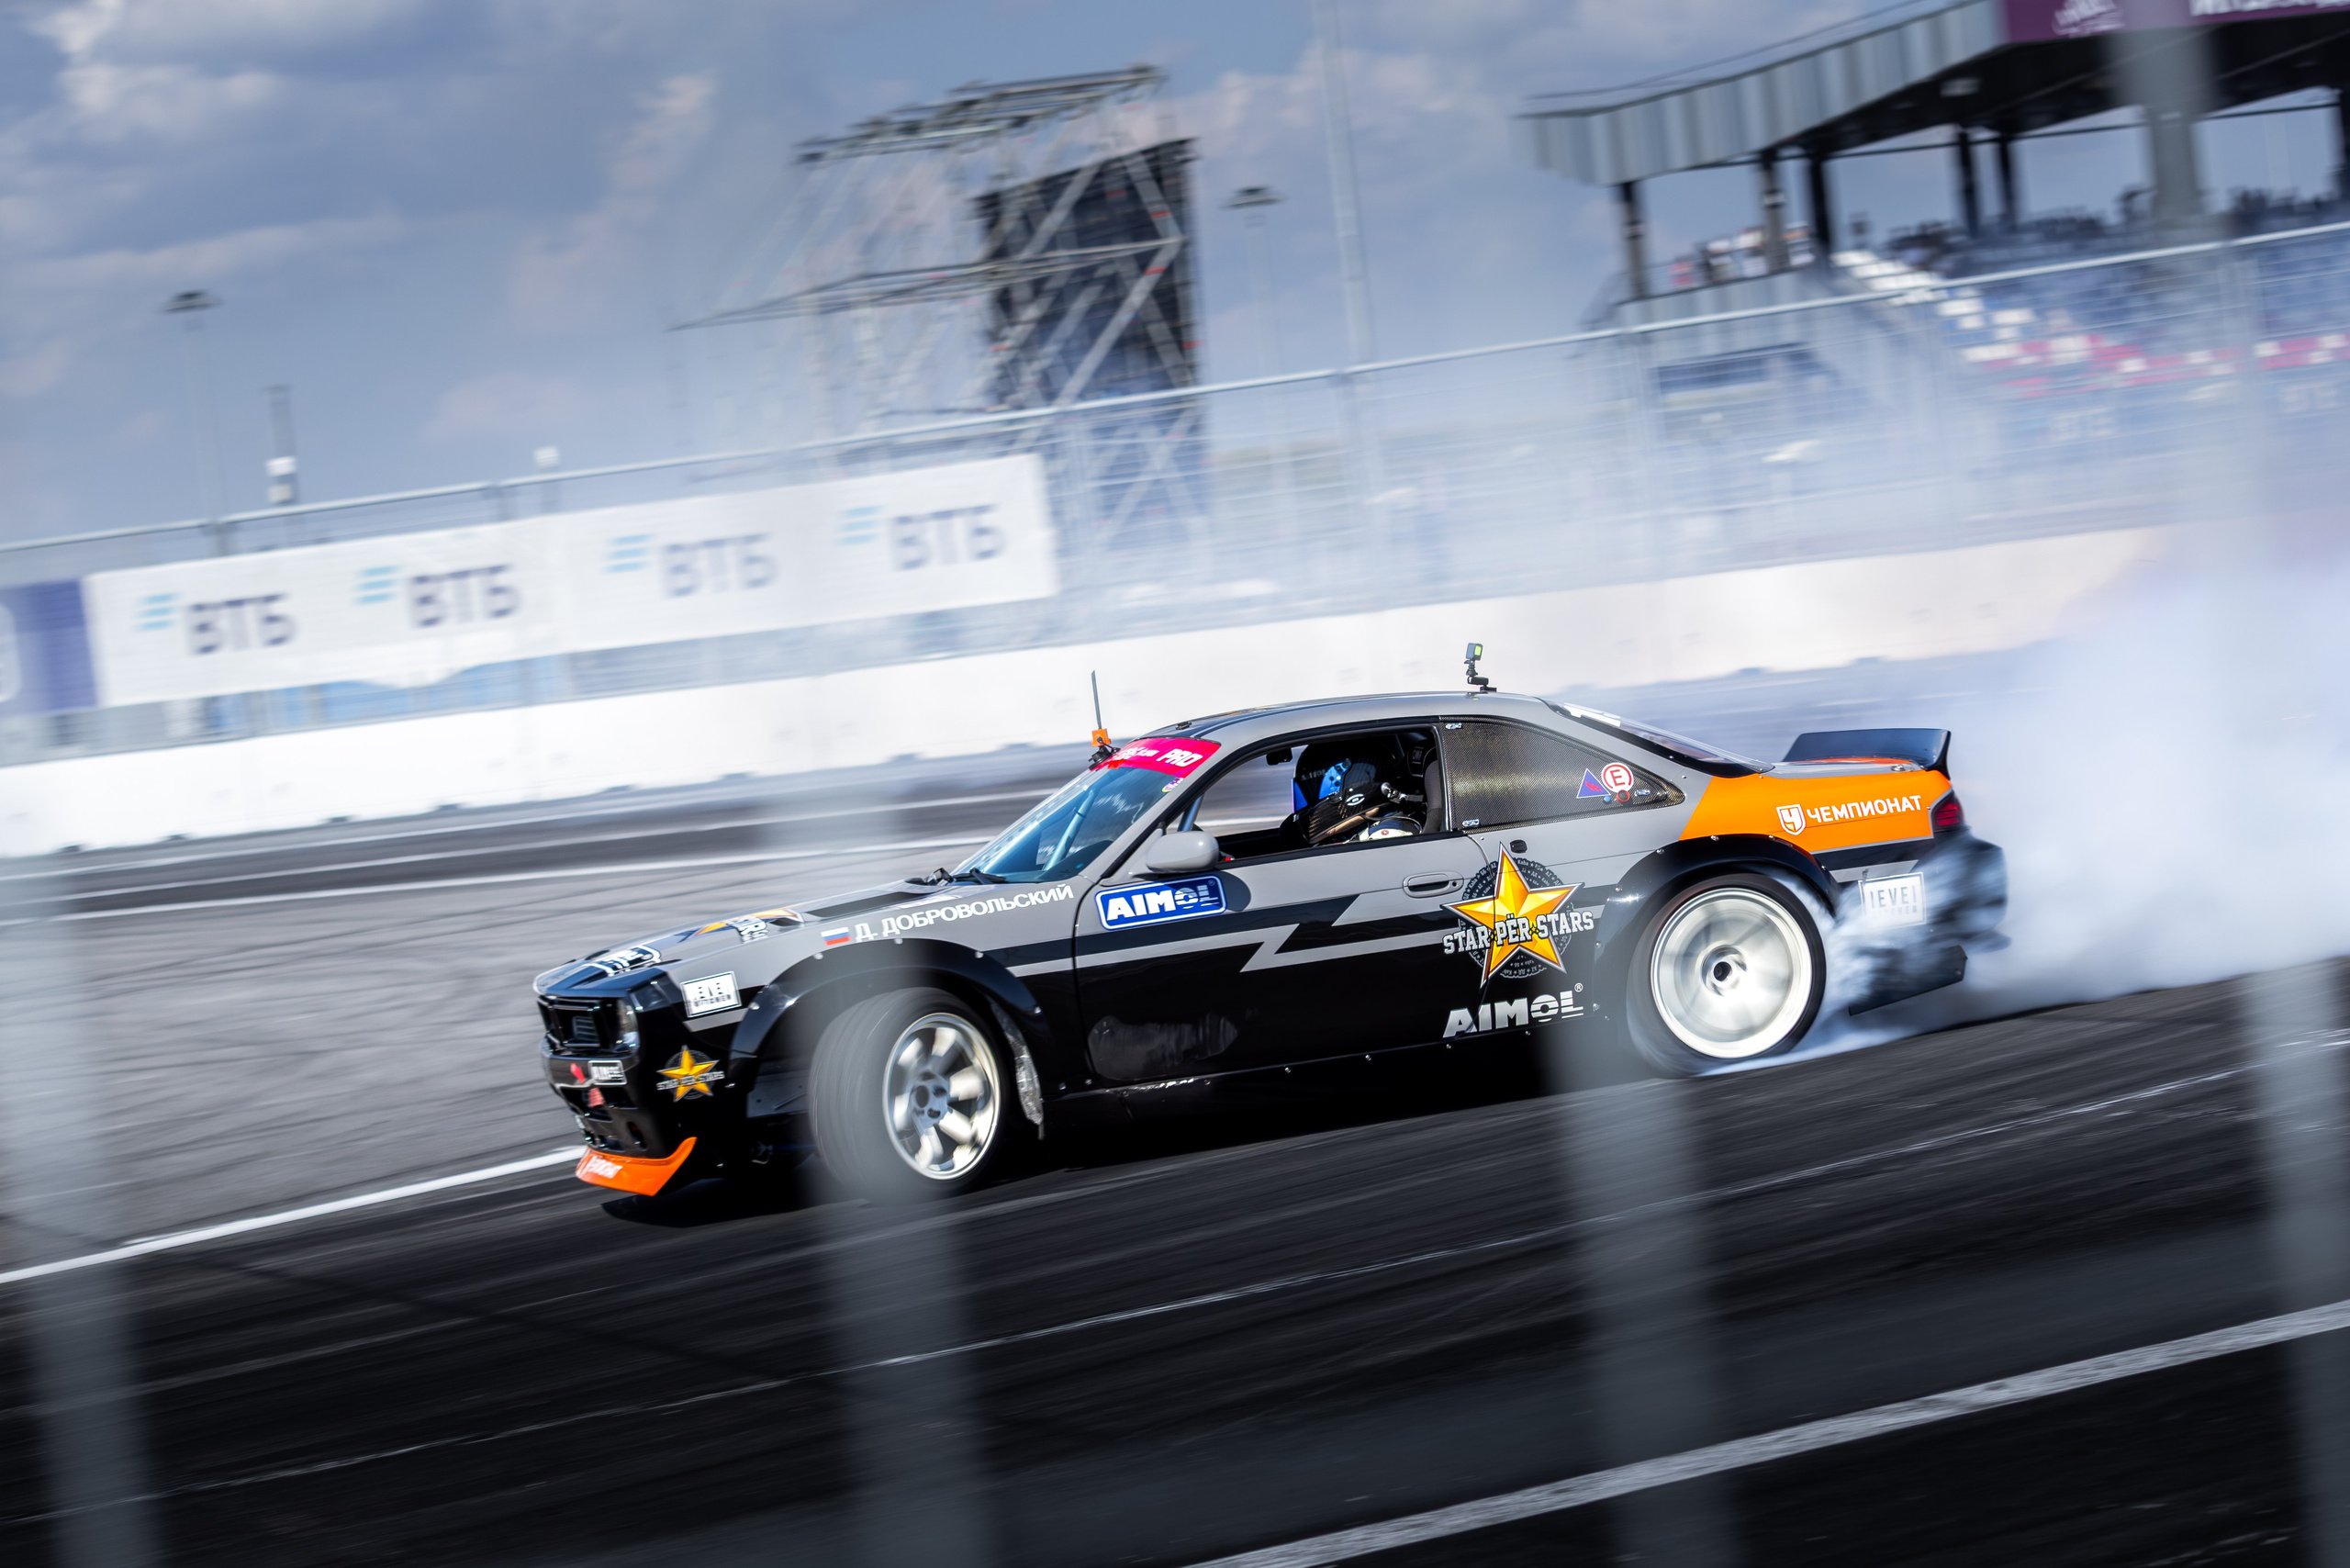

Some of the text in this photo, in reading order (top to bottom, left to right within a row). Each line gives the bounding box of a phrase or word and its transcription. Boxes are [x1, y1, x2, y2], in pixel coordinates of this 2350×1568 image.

[1807, 795, 1922, 823] ЧЕМПИОНАТ
[881, 883, 1074, 937] ДОБРОВОЛЬСКИЙ
[1106, 884, 1220, 921] AIMOL
[1442, 925, 1491, 954] STAR
[1536, 912, 1595, 938] STARS
[1442, 991, 1583, 1038] AIMOL
